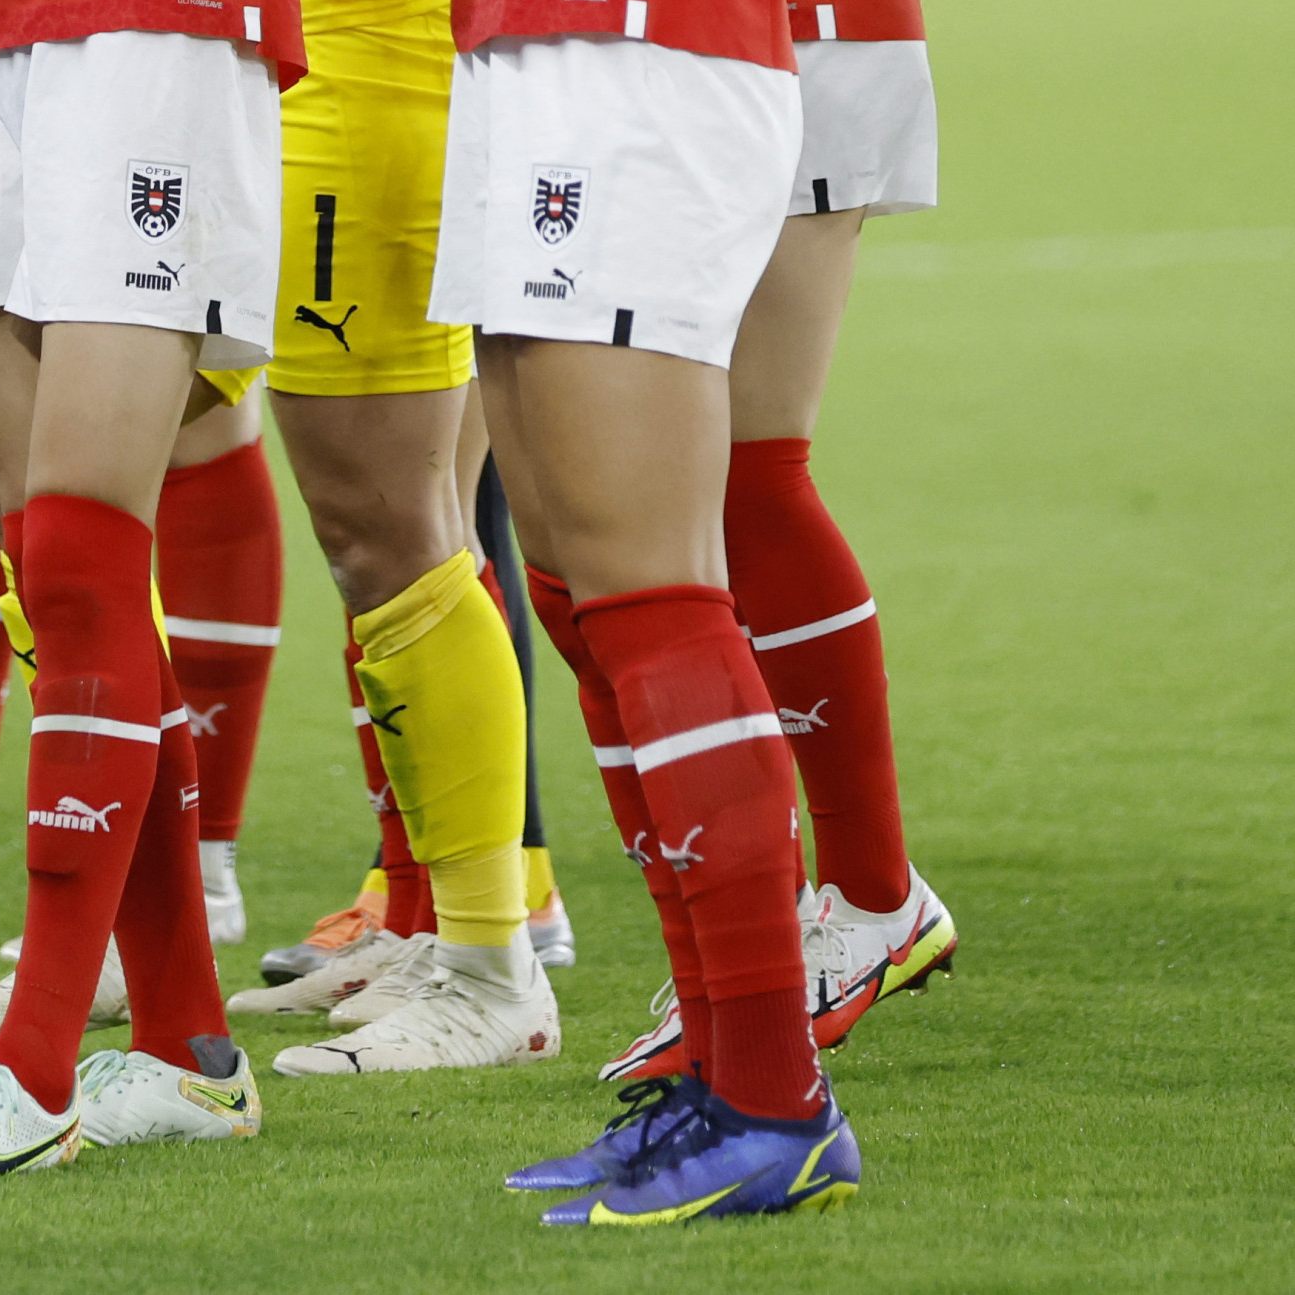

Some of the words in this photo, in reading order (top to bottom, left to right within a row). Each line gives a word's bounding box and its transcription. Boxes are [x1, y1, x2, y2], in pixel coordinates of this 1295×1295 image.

[315, 194, 336, 302] 1
[125, 271, 172, 292] PUMA
[524, 280, 567, 301] PUMA
[28, 810, 96, 833] PUMA
